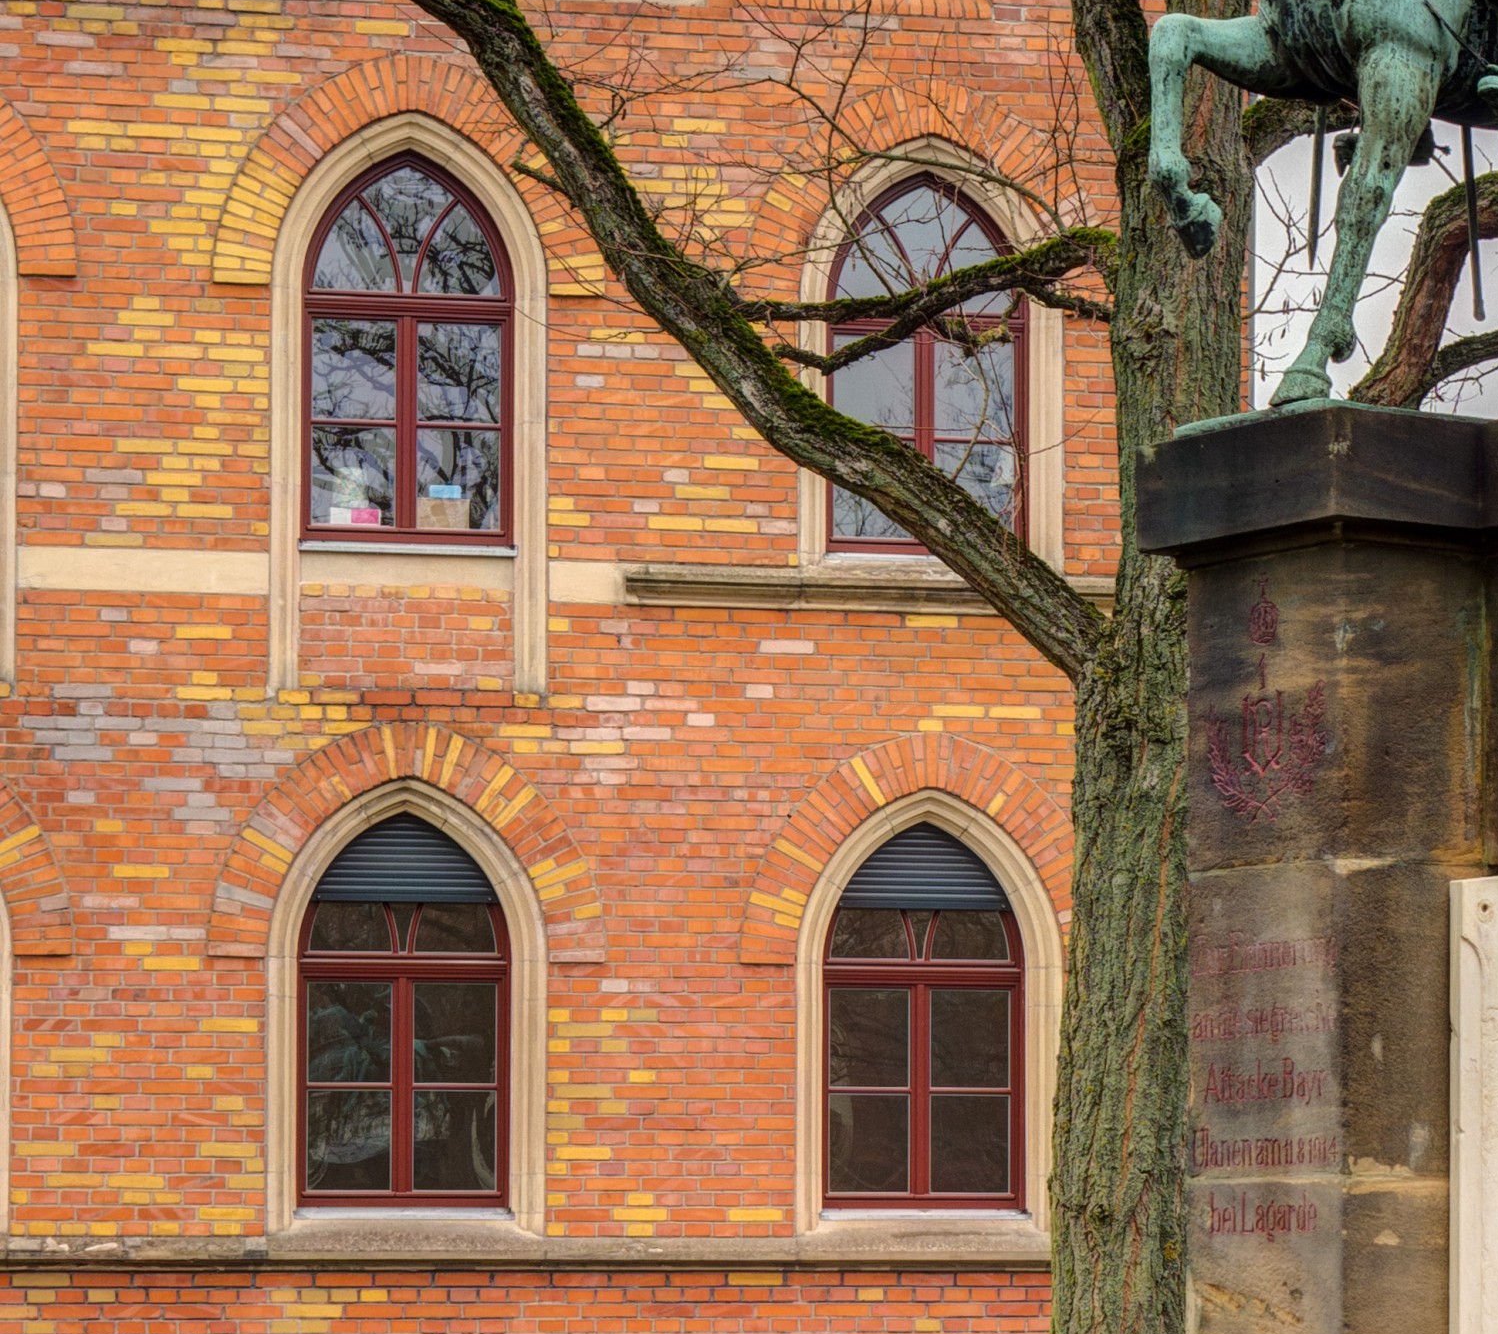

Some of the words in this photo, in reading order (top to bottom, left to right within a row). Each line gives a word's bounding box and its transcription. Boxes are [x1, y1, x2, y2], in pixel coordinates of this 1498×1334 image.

[1204, 1060, 1280, 1104] Attacke
[1192, 1125, 1254, 1168] Ulanen
[1255, 1138, 1283, 1166] am
[1209, 1191, 1237, 1236] bei
[1241, 1189, 1318, 1243] Lagarde
